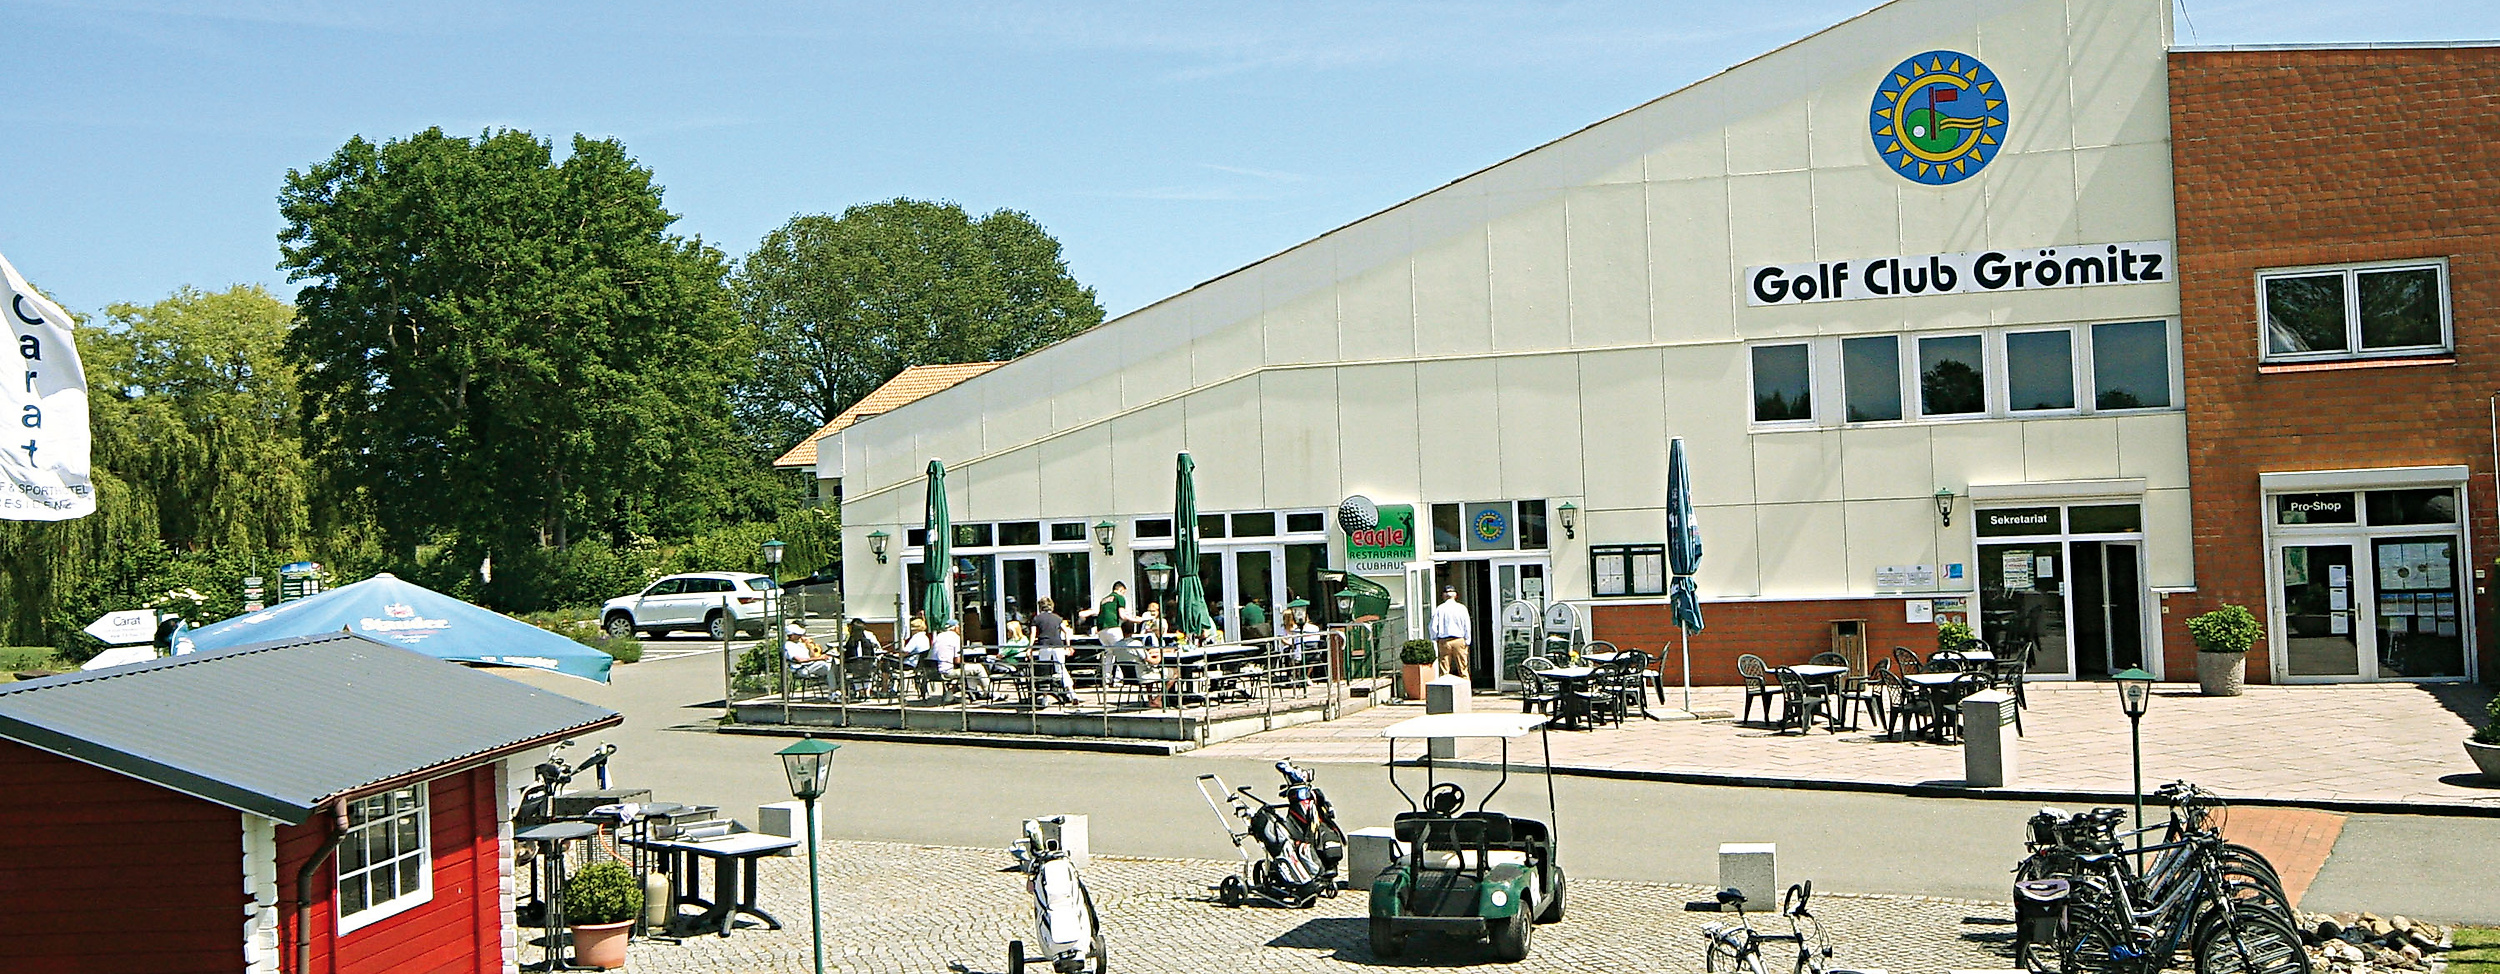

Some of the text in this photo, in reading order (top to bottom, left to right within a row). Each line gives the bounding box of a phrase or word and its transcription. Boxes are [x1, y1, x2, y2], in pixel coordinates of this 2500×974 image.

[1753, 244, 2164, 303] Golf Club Grömitz
[12, 293, 45, 469] Carat
[2290, 501, 2342, 513] Pro-Shop
[1990, 513, 2048, 526] Sekretariat
[1352, 526, 1403, 548] eagle
[1349, 549, 1413, 560] RESTAURANT
[113, 616, 141, 627] Carat
